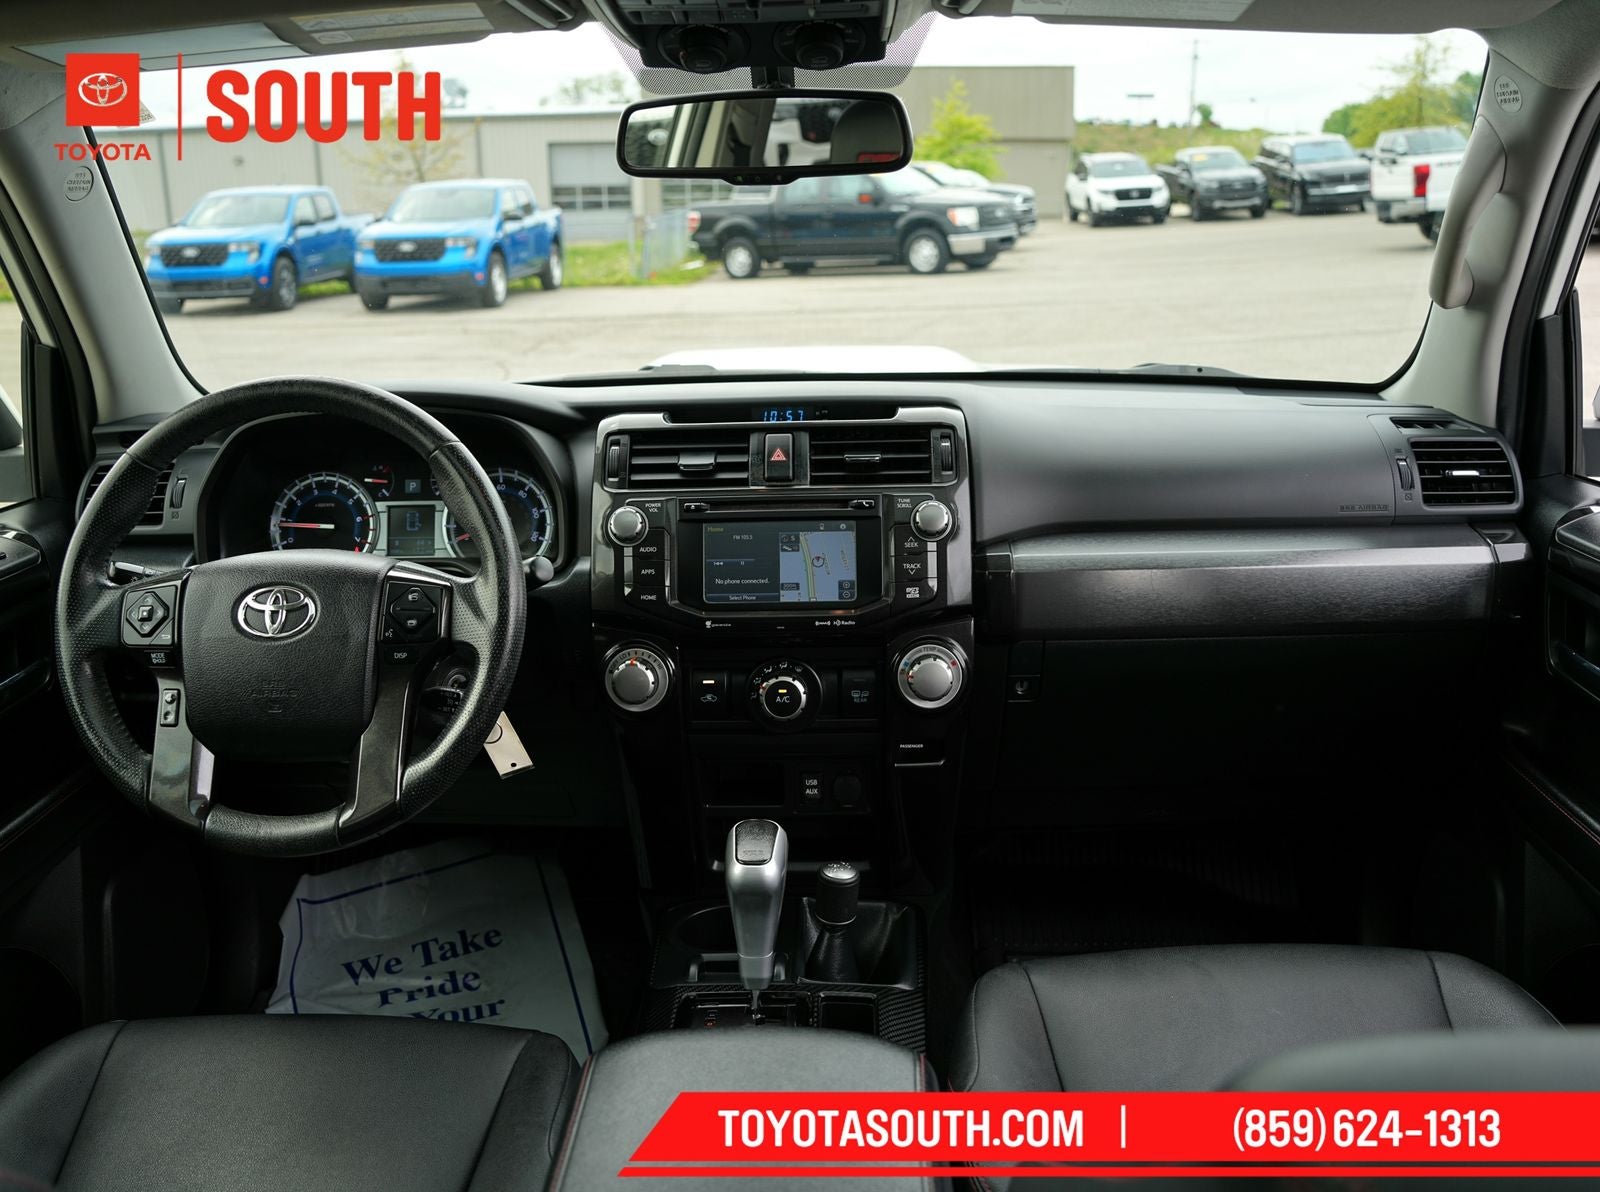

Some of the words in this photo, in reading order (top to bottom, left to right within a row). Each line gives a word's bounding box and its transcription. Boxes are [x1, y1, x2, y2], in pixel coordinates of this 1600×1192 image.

[763, 409, 804, 422] 10:57
[775, 695, 790, 703] A/C
[341, 954, 404, 986] We
[411, 928, 504, 968] Take
[376, 970, 482, 1008] Pride
